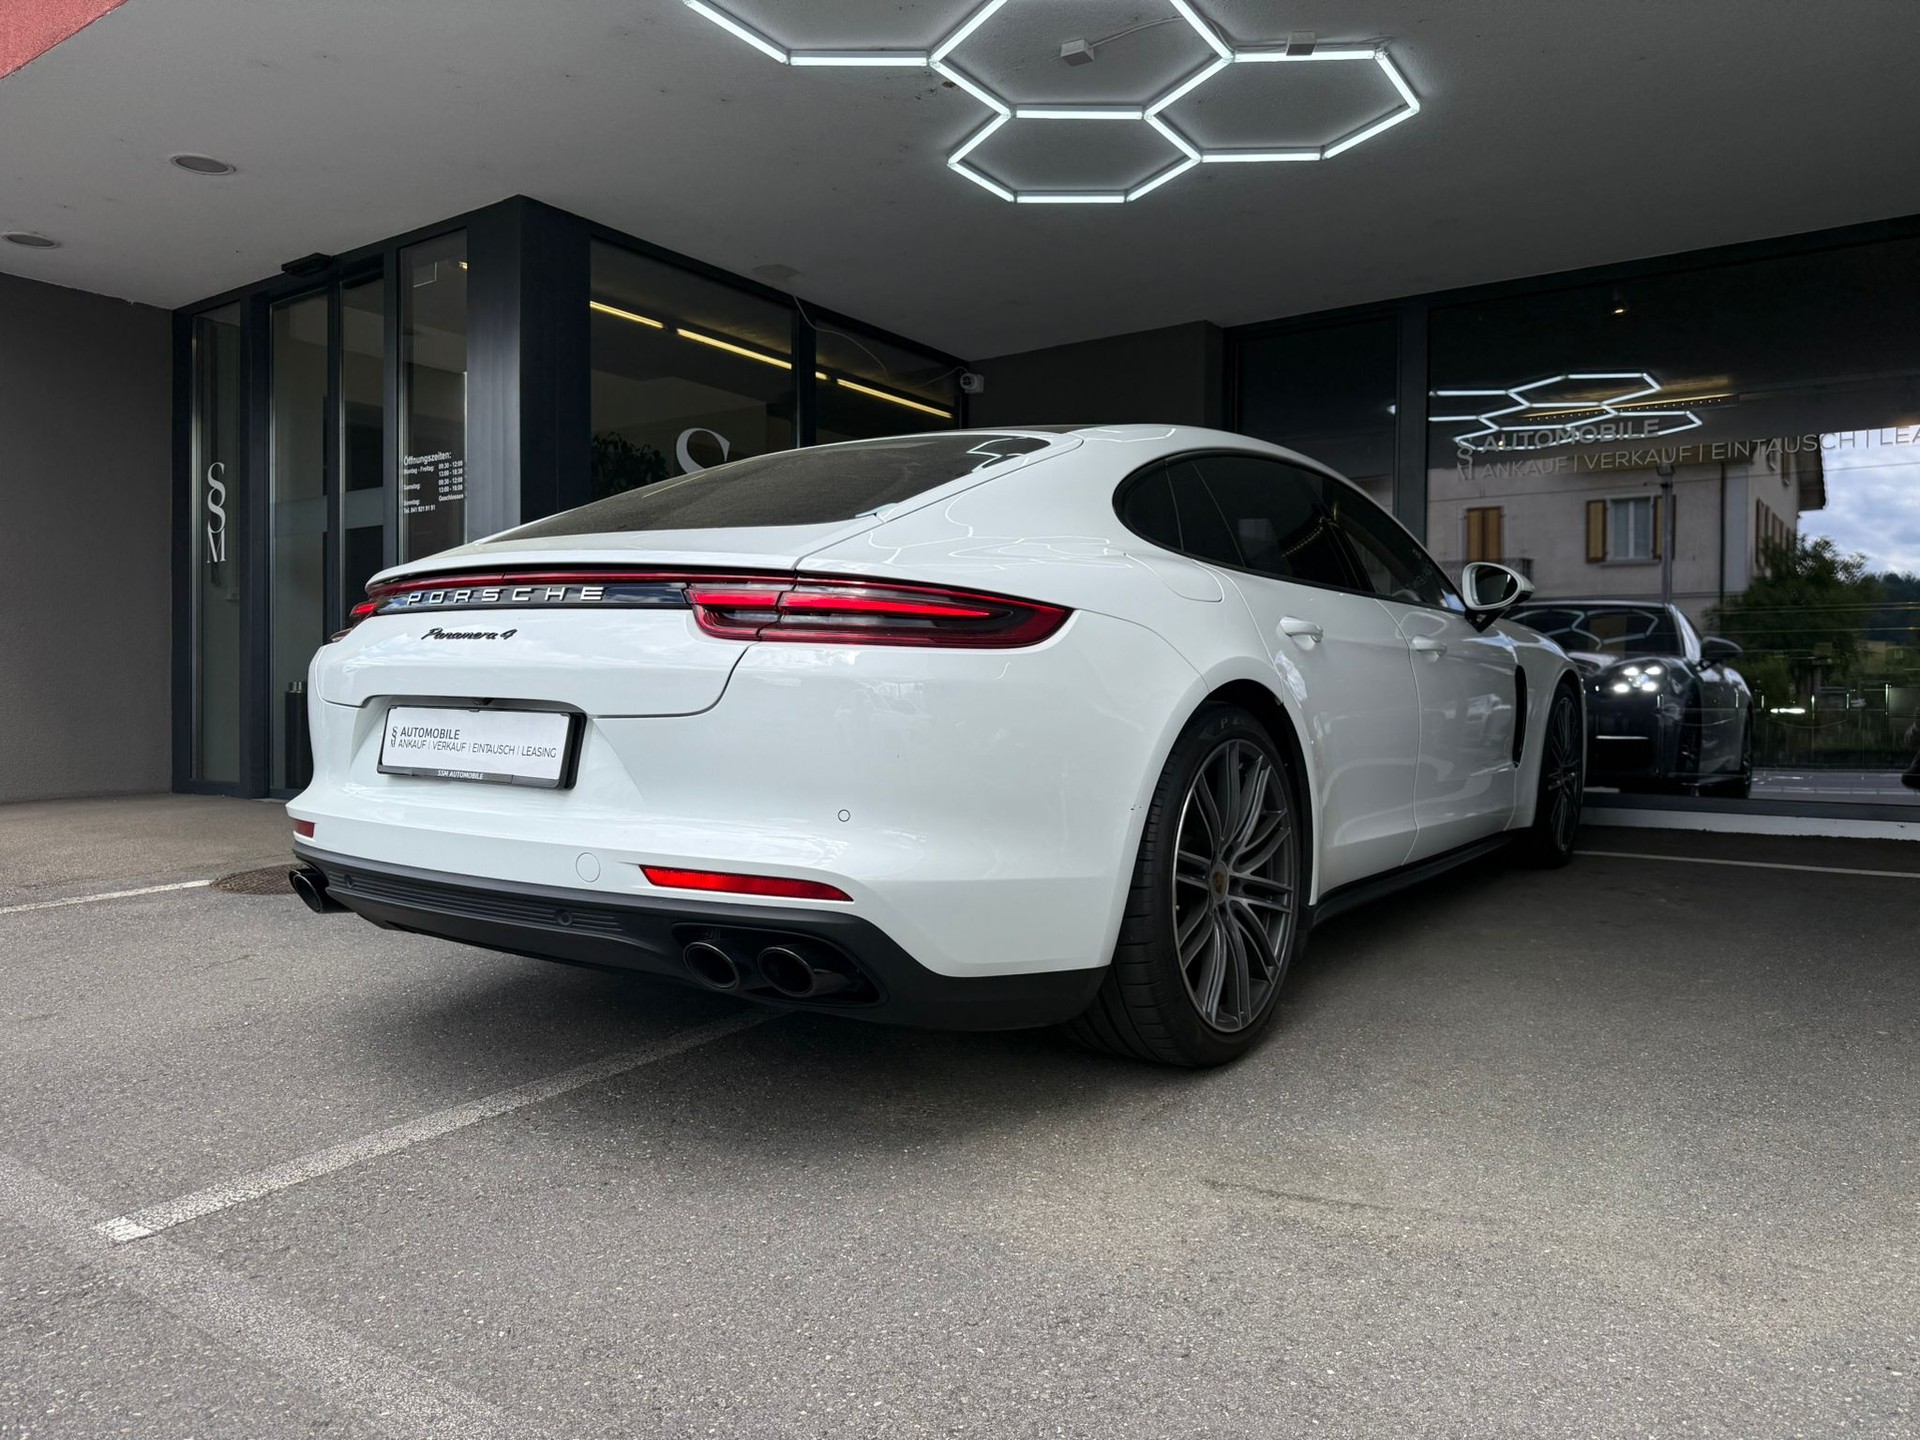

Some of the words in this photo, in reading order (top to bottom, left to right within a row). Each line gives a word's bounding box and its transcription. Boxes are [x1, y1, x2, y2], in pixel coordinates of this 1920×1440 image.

[1481, 419, 1660, 453] AUTOMOBILE
[1480, 456, 1569, 479] ANKAUF
[1583, 445, 1692, 470] VERKAUF
[1711, 430, 1856, 460] EINTAUSCH
[407, 586, 604, 606] PORSCHE
[421, 627, 498, 640] Panamera
[499, 628, 518, 640] 4
[400, 726, 461, 740] AUTOMOBILE
[398, 739, 427, 750] ANKAUF
[432, 740, 467, 752] VERKAUF
[472, 743, 515, 755] EINTAUSCH
[521, 746, 557, 758] LEASING
[449, 770, 484, 780] AUTOMOBILE
